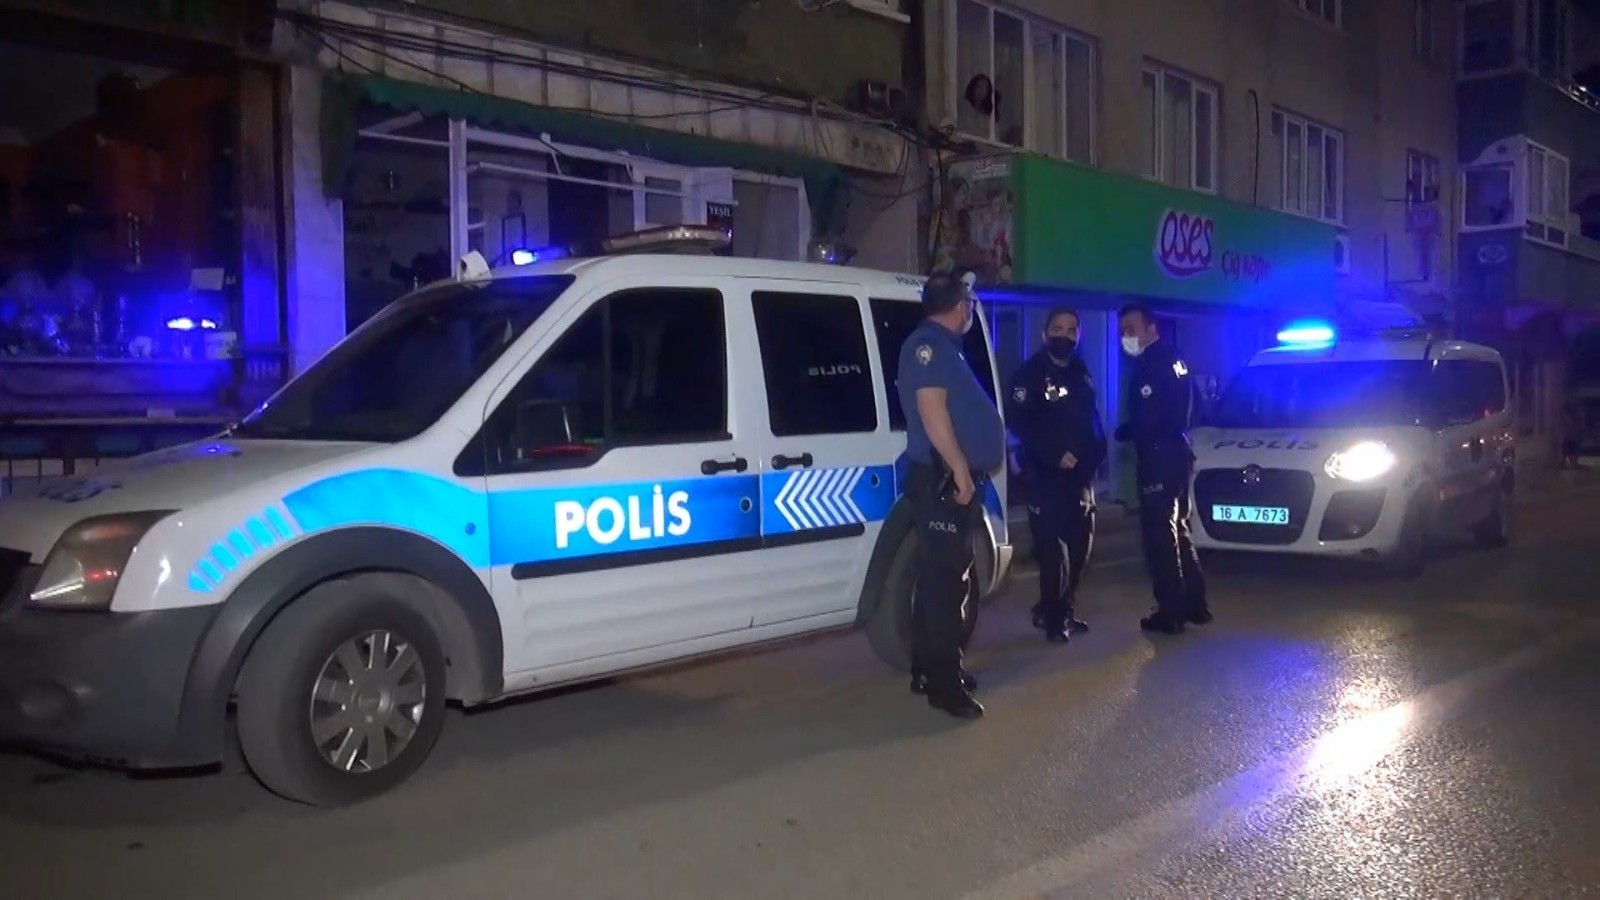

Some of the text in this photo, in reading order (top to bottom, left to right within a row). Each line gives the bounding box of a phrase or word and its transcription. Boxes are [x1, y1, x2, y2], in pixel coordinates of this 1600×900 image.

[554, 484, 691, 549] POLİS
[1220, 507, 1287, 522] 16 A 7673
